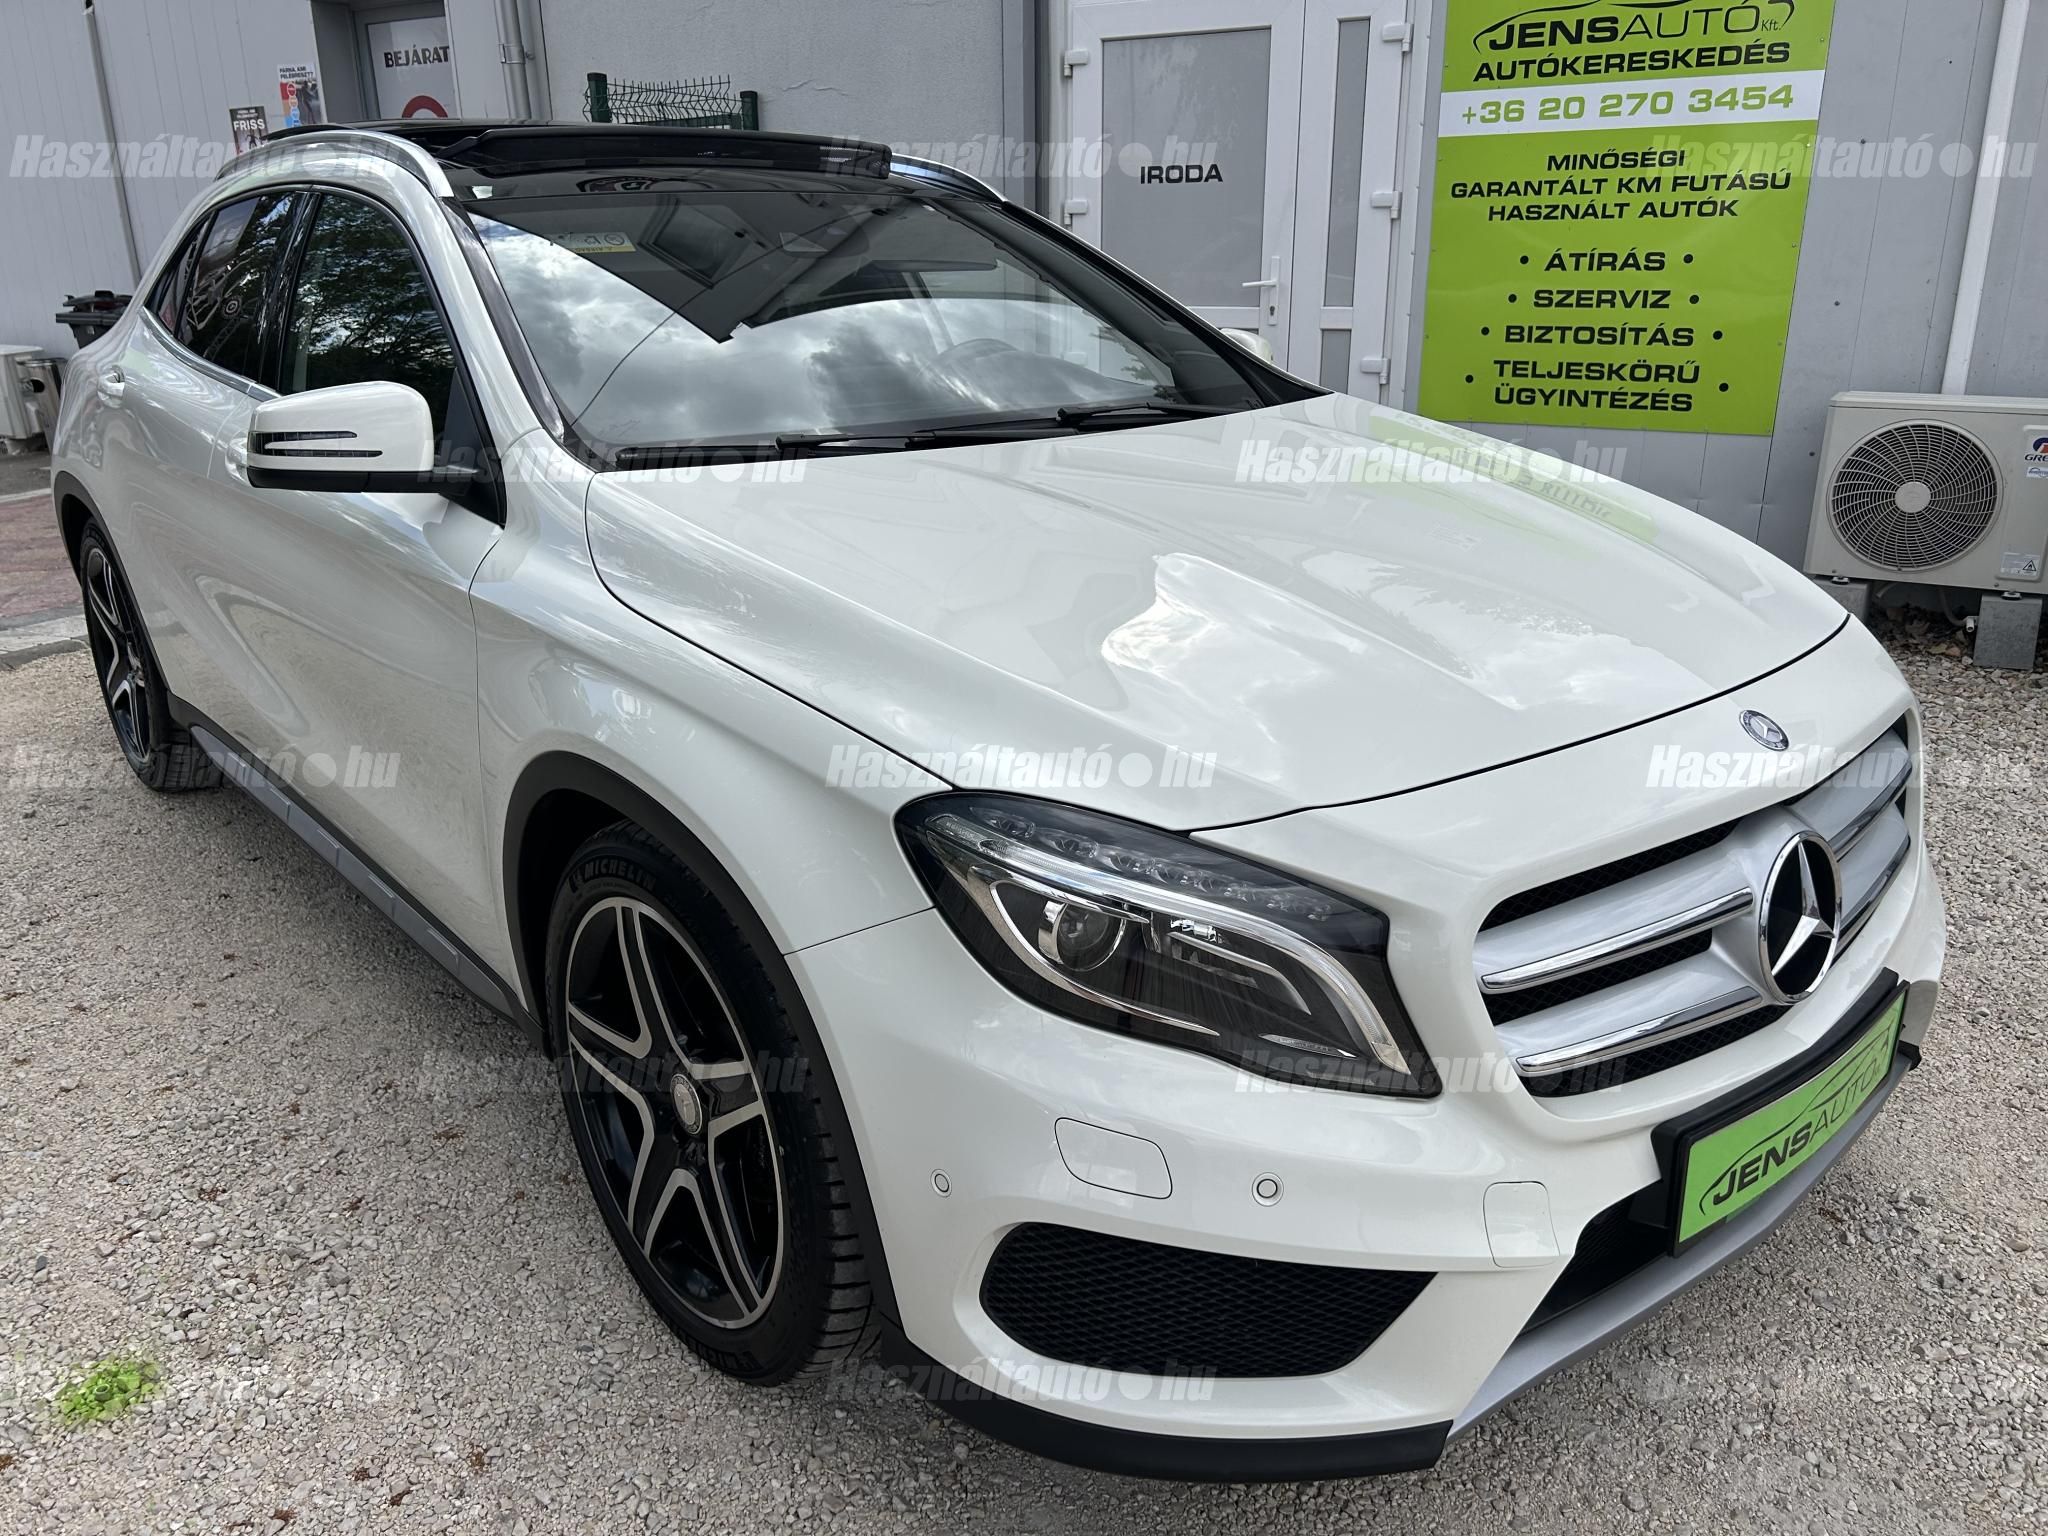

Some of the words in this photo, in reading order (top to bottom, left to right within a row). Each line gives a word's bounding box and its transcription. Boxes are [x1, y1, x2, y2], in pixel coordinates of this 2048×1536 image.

[1489, 0, 1759, 50] JENSAUTÓ
[1761, 19, 1782, 31] Kft.
[384, 44, 450, 68] BEJÁRAT
[1473, 38, 1790, 82] AUTÓKERESKEDÉS
[1462, 99, 1525, 124] +36
[1538, 96, 1585, 121] 20
[1599, 91, 1673, 117] 270
[1688, 84, 1793, 113] 3454
[233, 118, 265, 131] FRISS
[1547, 148, 1685, 171] MINŐSÉGI
[1140, 163, 1224, 185] IRODA
[1451, 175, 1608, 198] GARANTÁLT
[1617, 176, 1661, 193] KM
[1671, 168, 1791, 192] FUTÁSÚ
[1488, 199, 1630, 221] HASZNÁLT
[1638, 196, 1739, 218] AUTÓK
[1544, 247, 1666, 271] ÁTÍRÁS
[1533, 289, 1671, 309] SZERVIZ
[1505, 322, 1694, 347] BIZTOSÍTÁS
[1493, 359, 1700, 384] TELJESKÖRŰ
[1494, 383, 1693, 412] ÜGYINTÉZÉS
[584, 858, 657, 891] MICHELIN
